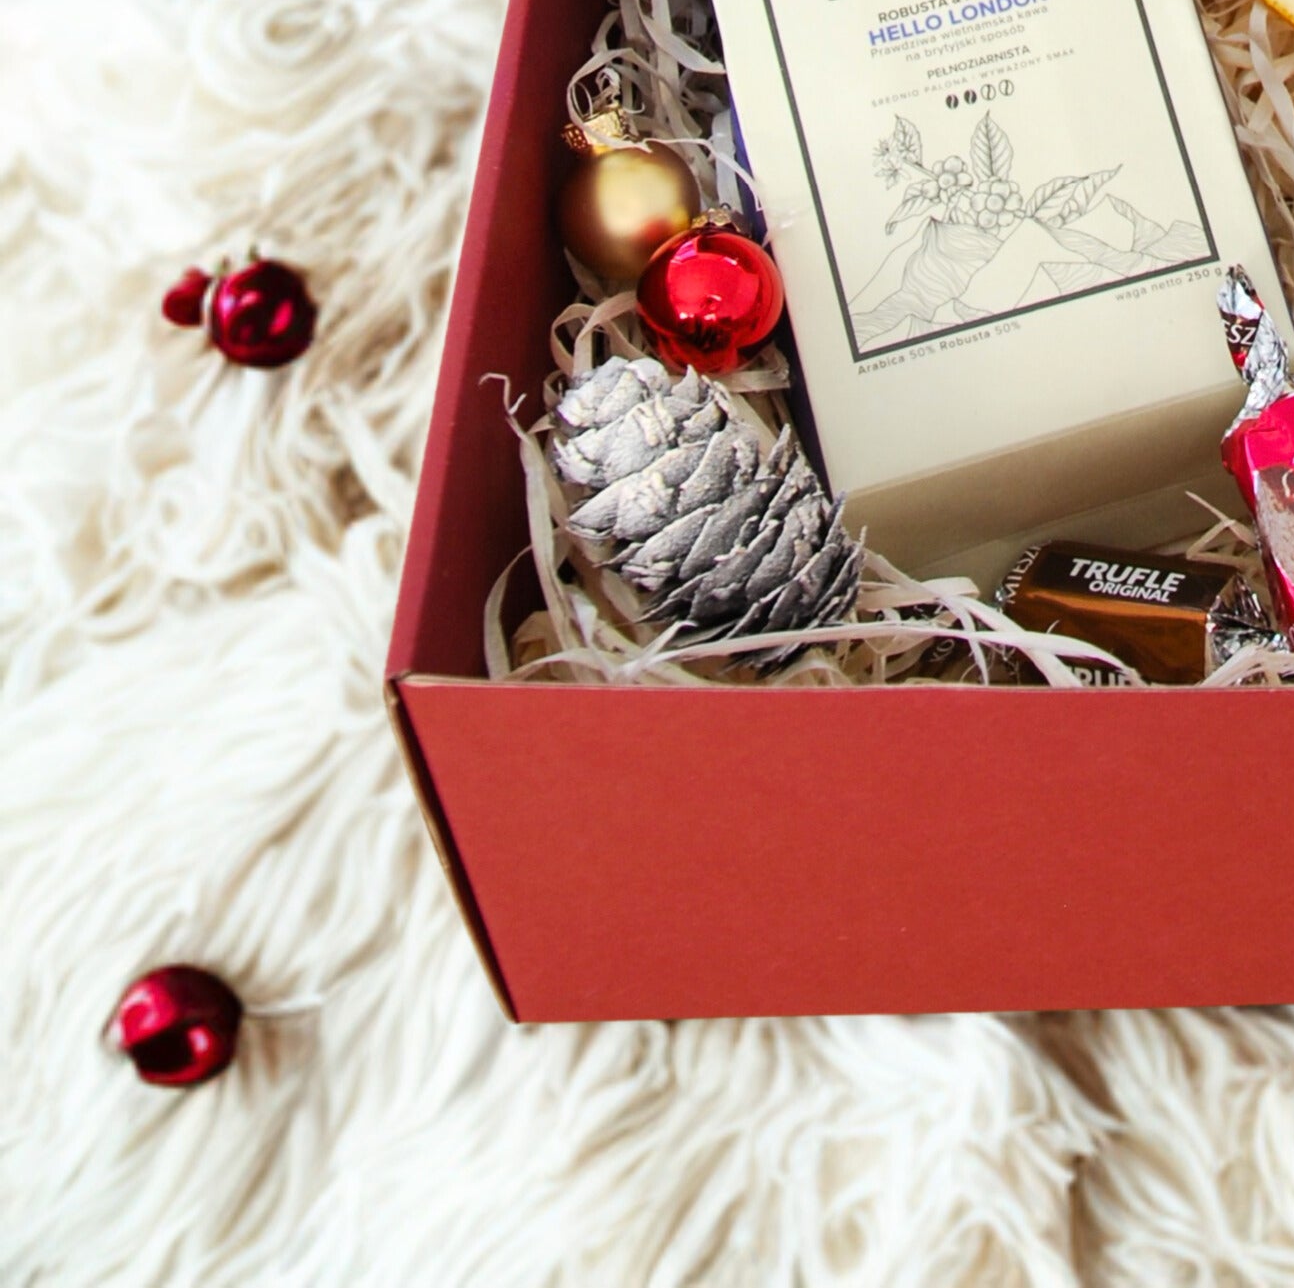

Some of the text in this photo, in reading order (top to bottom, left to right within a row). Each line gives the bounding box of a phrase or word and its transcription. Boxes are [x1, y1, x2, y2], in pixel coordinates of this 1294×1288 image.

[868, 14, 943, 46] HELLO
[870, 4, 1048, 59] Prawdziwa wietnamska kawa
[905, 24, 1026, 63] na brytyjski sposób
[1115, 286, 1148, 302] waga
[1150, 276, 1183, 292] netto
[1186, 269, 1211, 283] 250
[857, 354, 906, 376] Arabica
[939, 329, 992, 352] Robusta
[1069, 557, 1186, 592] TRUFLE
[1088, 579, 1170, 603] ORIGINAL
